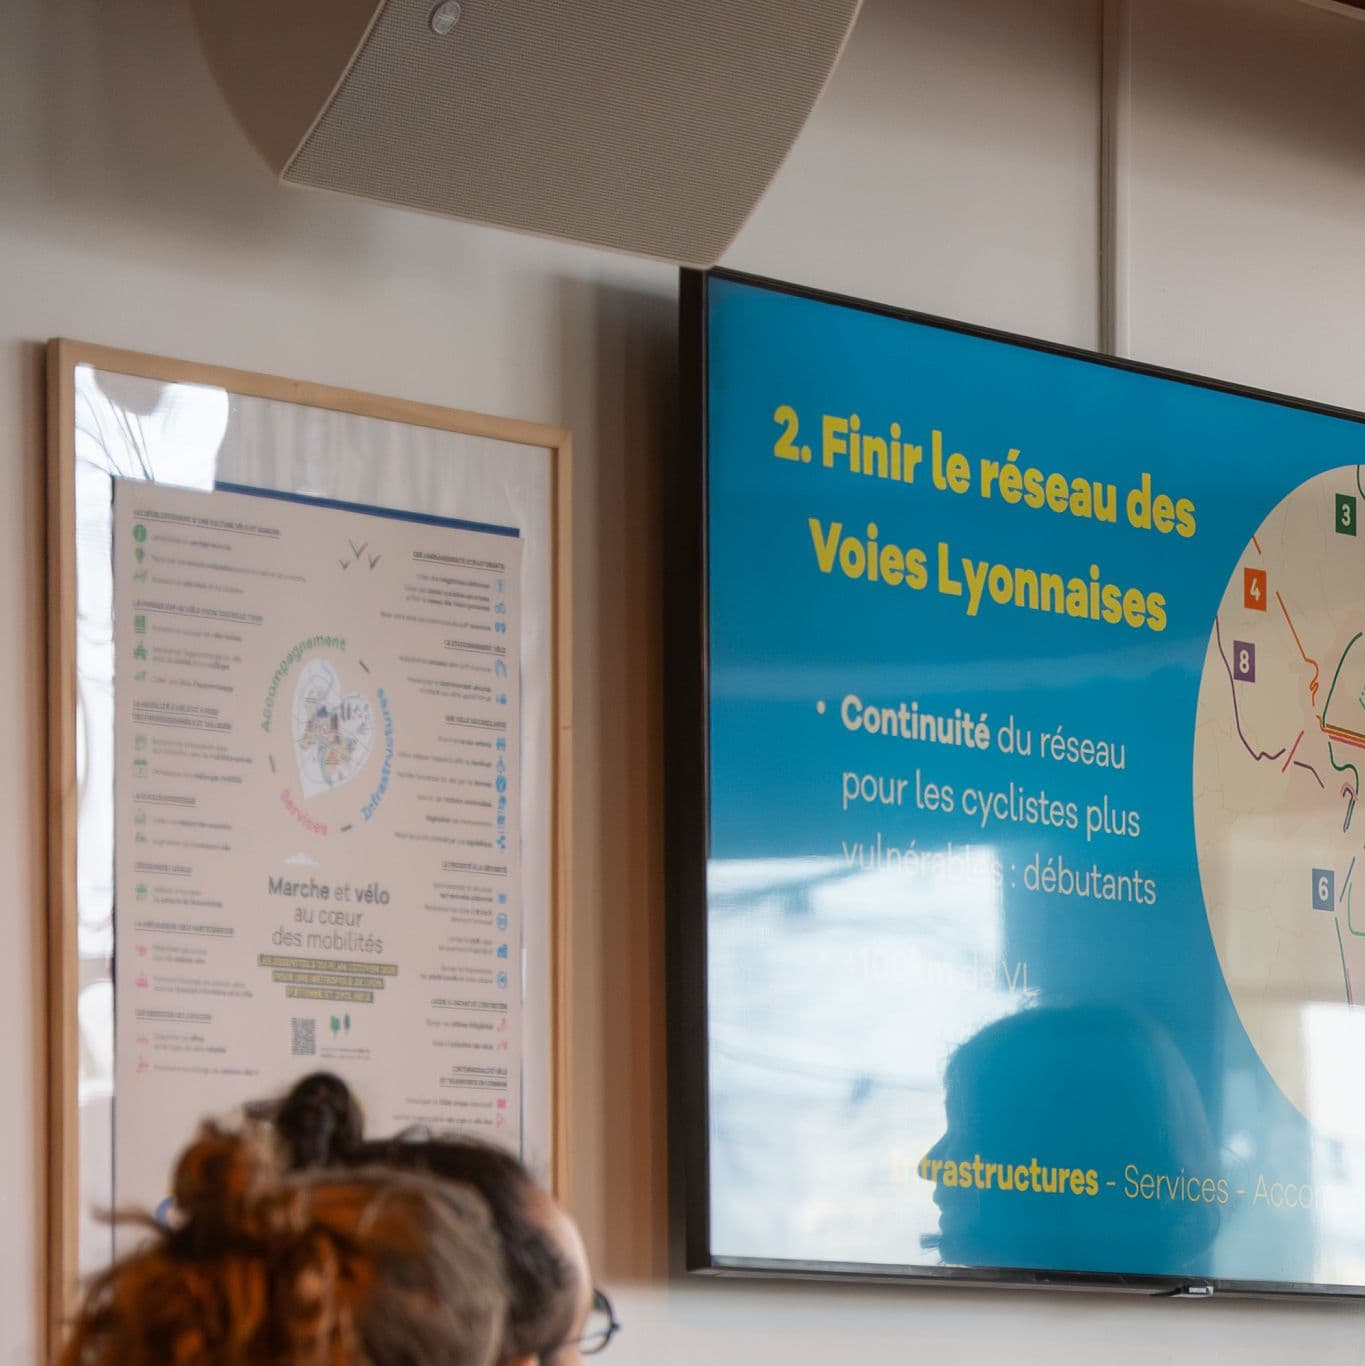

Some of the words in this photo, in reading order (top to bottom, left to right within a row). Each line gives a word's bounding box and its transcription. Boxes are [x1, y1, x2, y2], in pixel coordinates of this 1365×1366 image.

[774, 404, 811, 462] 2.
[822, 413, 922, 485] Finir
[932, 430, 971, 493] le
[981, 449, 1117, 522] réseau
[1126, 473, 1196, 538] des
[1341, 503, 1352, 527] 3
[808, 518, 928, 590] Voies
[938, 541, 1168, 631] Lyonnaises
[1249, 577, 1261, 602] 4
[1239, 649, 1251, 675] 8
[841, 694, 990, 750] Continuité
[998, 715, 1031, 755] du
[1041, 724, 1125, 770] réseau
[843, 770, 908, 811] pour
[916, 769, 954, 813] les
[962, 782, 1079, 829] cyclistes
[1086, 794, 1140, 842] plus
[267, 876, 330, 900] Marche
[334, 883, 352, 902] et
[354, 882, 391, 905] vélo
[1023, 852, 1156, 905] débutants
[1317, 876, 1330, 902] 6
[294, 906, 313, 924] au
[271, 925, 302, 948] des
[306, 928, 384, 954] mobilités
[1124, 1163, 1229, 1205] Services
